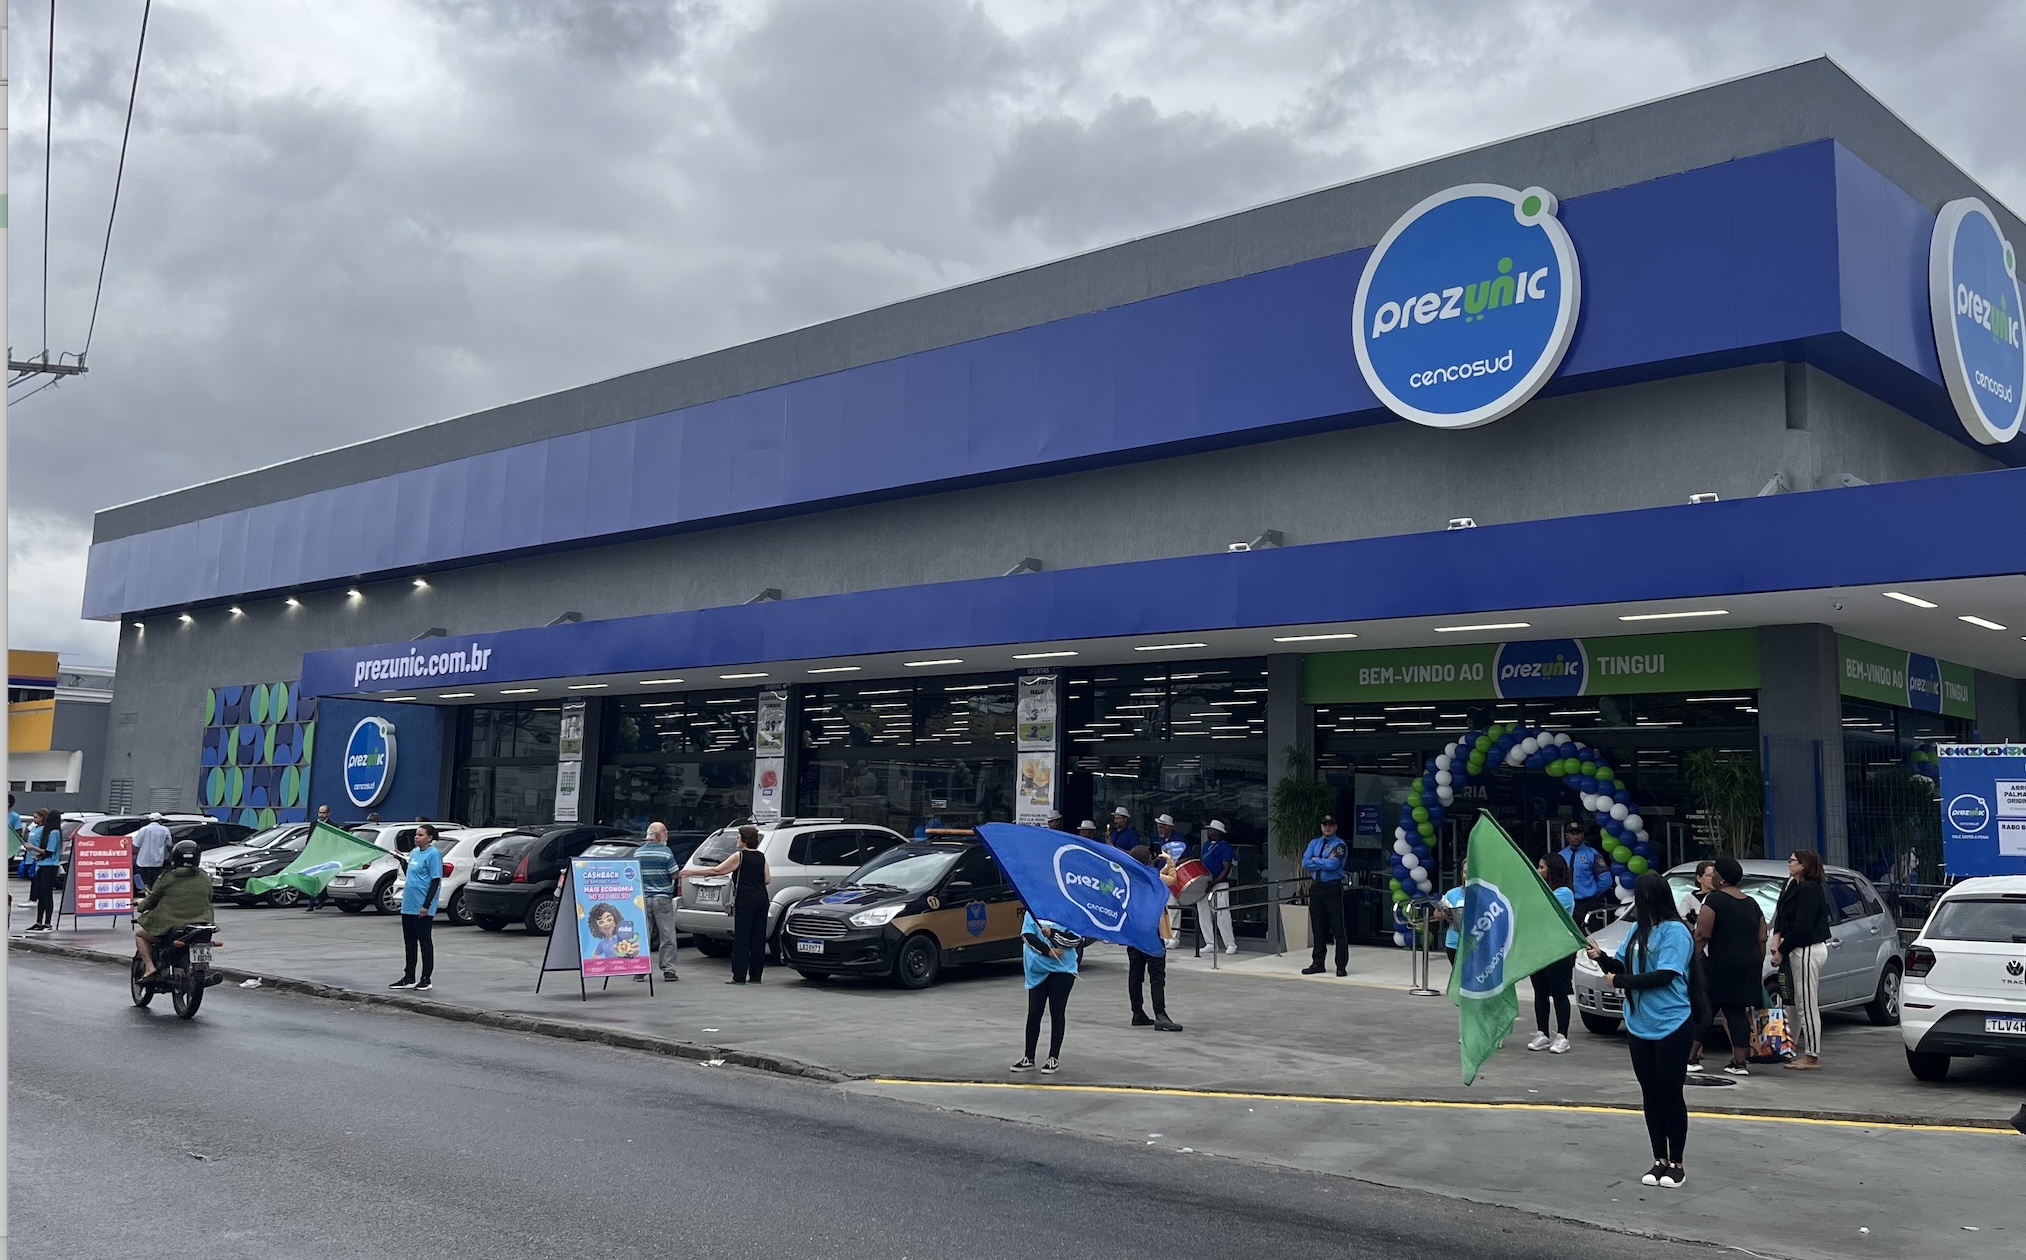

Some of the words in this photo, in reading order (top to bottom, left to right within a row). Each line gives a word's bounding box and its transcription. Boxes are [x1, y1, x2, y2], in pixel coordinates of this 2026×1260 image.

[1409, 349, 1513, 389] cencosud
[1975, 370, 2013, 403] cencosud
[354, 643, 492, 687] prezunic.com.br
[1027, 667, 1050, 675] OFERTAS
[1359, 664, 1455, 685] BEM-VINDO
[1459, 663, 1484, 682] AO
[1597, 654, 1665, 676] TINGUI
[1846, 658, 1891, 687] BEM-VINDO
[1892, 669, 1904, 689] AO
[1945, 681, 1969, 702] TINGUI
[79, 849, 128, 857] RETORNÁVEIS
[601, 885, 634, 893] ECONOMIA
